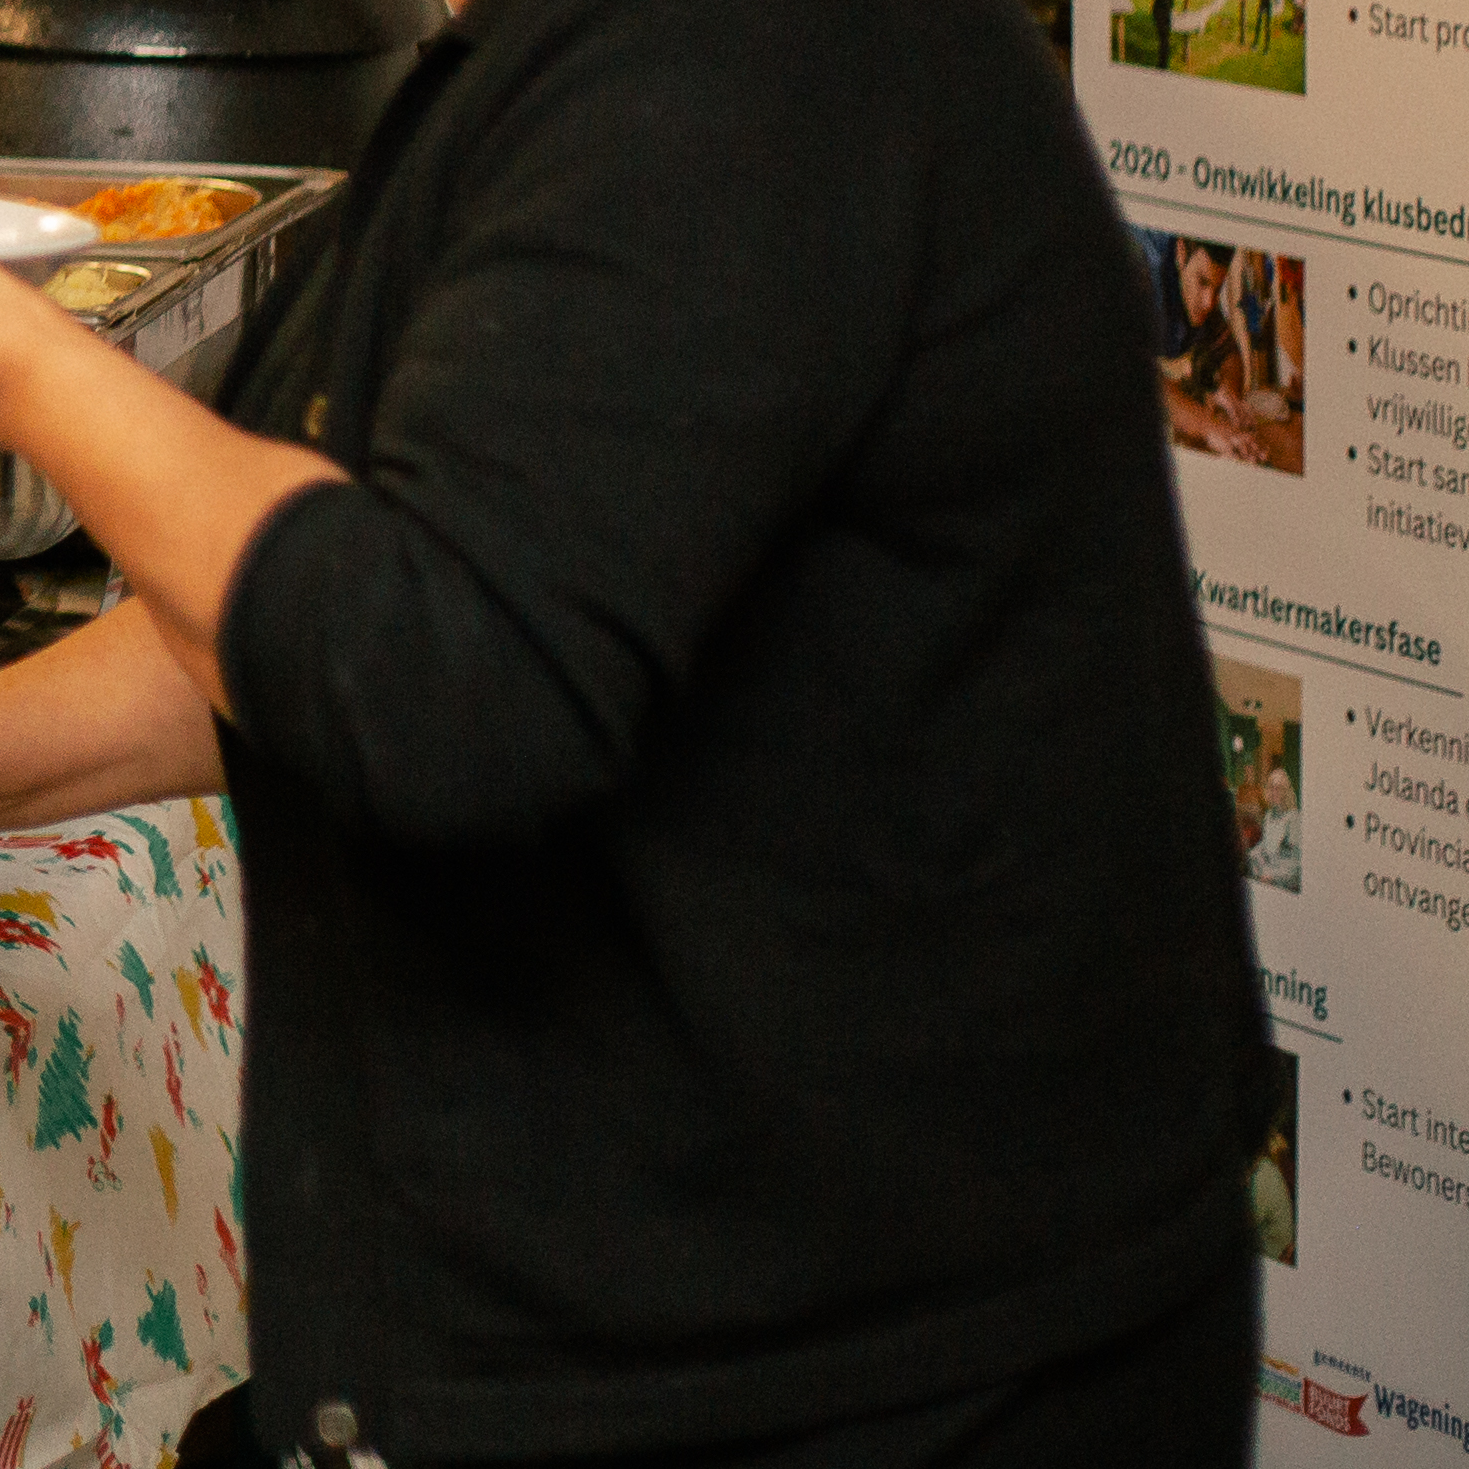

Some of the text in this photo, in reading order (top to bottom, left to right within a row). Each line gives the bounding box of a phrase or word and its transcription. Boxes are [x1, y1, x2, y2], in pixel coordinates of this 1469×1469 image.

[1369, 3, 1428, 43] Start
[1109, 140, 1170, 181] 2020
[1192, 157, 1356, 225] Ontwikkeling
[1364, 186, 1469, 239] klusbed
[1368, 335, 1460, 384] Klussen
[1368, 443, 1426, 486] Start
[1364, 762, 1459, 815] Jolanda
[1362, 1089, 1419, 1137] Start
